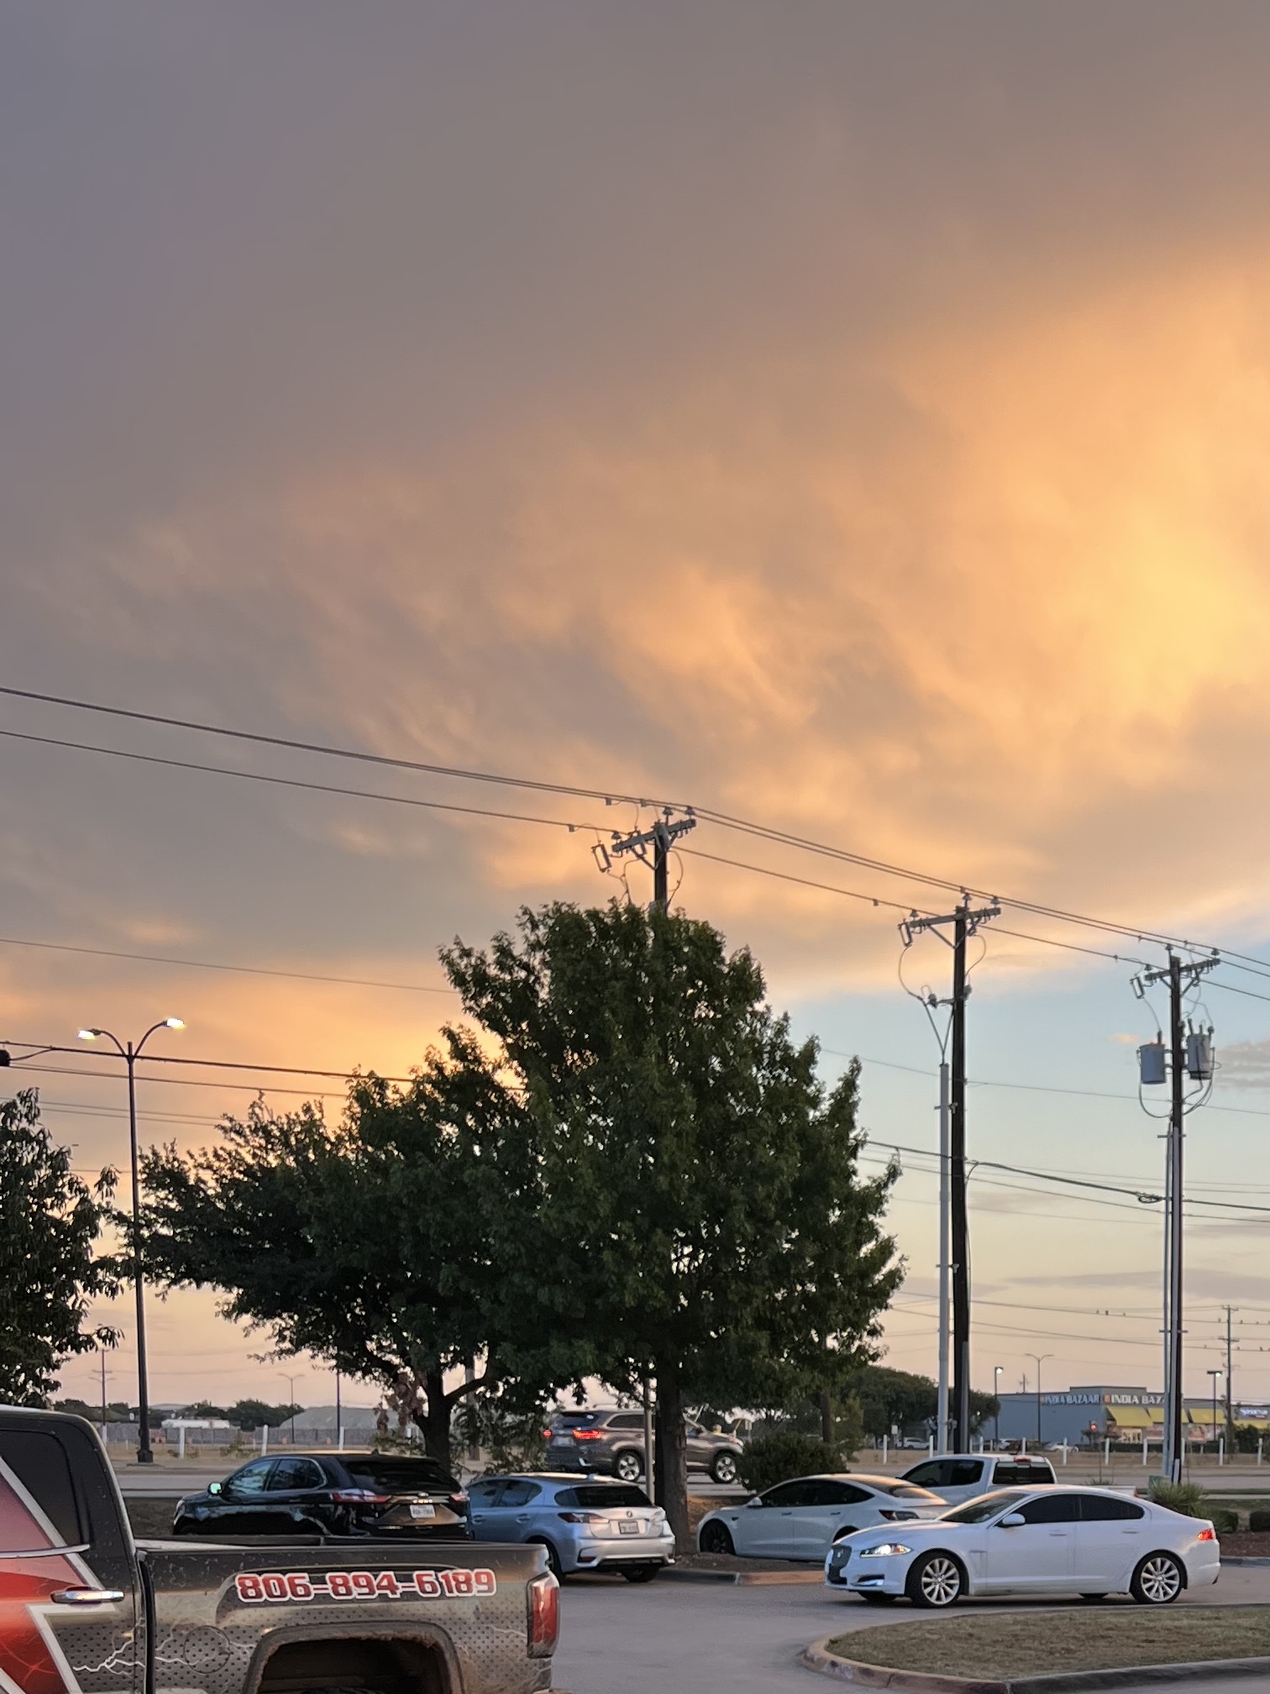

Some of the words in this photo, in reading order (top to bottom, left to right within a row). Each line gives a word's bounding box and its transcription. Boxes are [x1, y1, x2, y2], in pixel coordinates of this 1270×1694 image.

[1111, 1395, 1139, 1404] INDIA
[1141, 1396, 1165, 1404] BAZ
[235, 1568, 497, 1602] 806-894-6189
